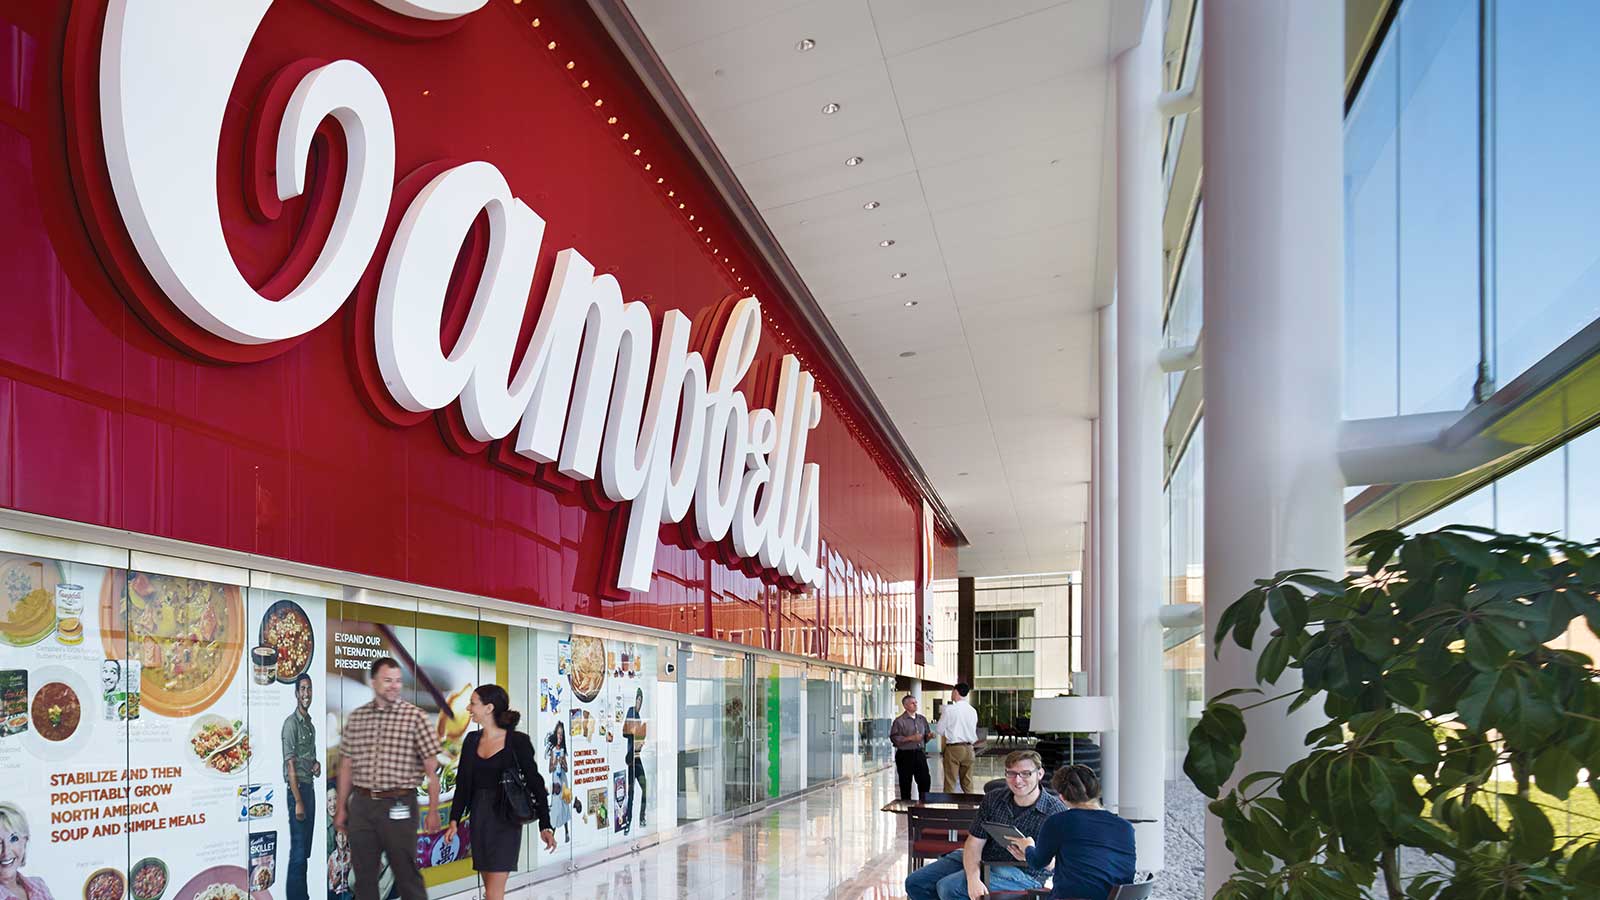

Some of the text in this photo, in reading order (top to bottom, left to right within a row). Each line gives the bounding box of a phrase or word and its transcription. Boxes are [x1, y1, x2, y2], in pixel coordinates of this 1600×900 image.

[100, 0, 822, 592] Campbell's
[334, 632, 381, 646] EXPAND OUR
[334, 646, 391, 658] INTERNATIONAL
[334, 659, 372, 670] PRESENCE
[50, 766, 182, 787] STABILIZE AND THEN
[51, 787, 132, 806] PROFITABLY
[134, 783, 173, 798] GROW
[51, 802, 159, 825] NORTH AMERICA
[51, 813, 206, 843] SOUP AND SIMPLE MEALS
